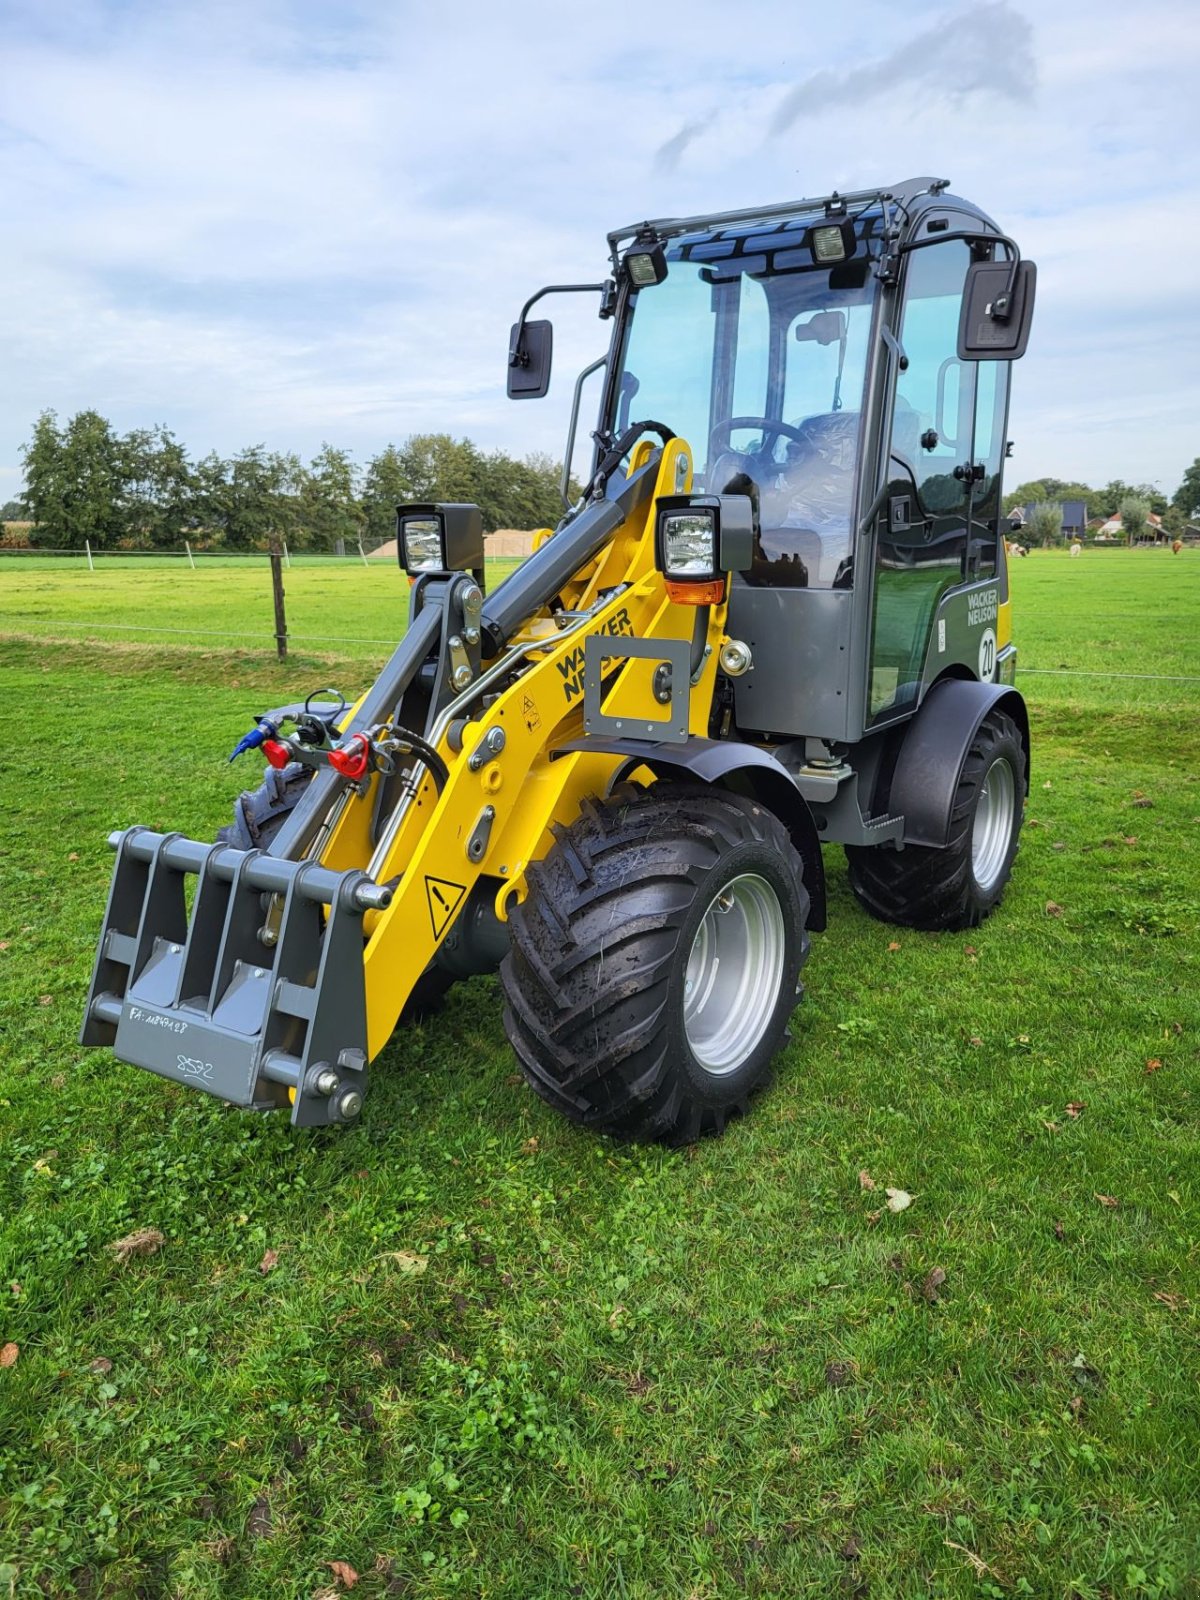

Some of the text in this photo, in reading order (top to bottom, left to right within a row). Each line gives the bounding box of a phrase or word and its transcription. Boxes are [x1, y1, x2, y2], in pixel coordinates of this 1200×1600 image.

[967, 589, 997, 610] WACKER
[967, 604, 997, 627] NEUSON
[982, 638, 993, 676] 20
